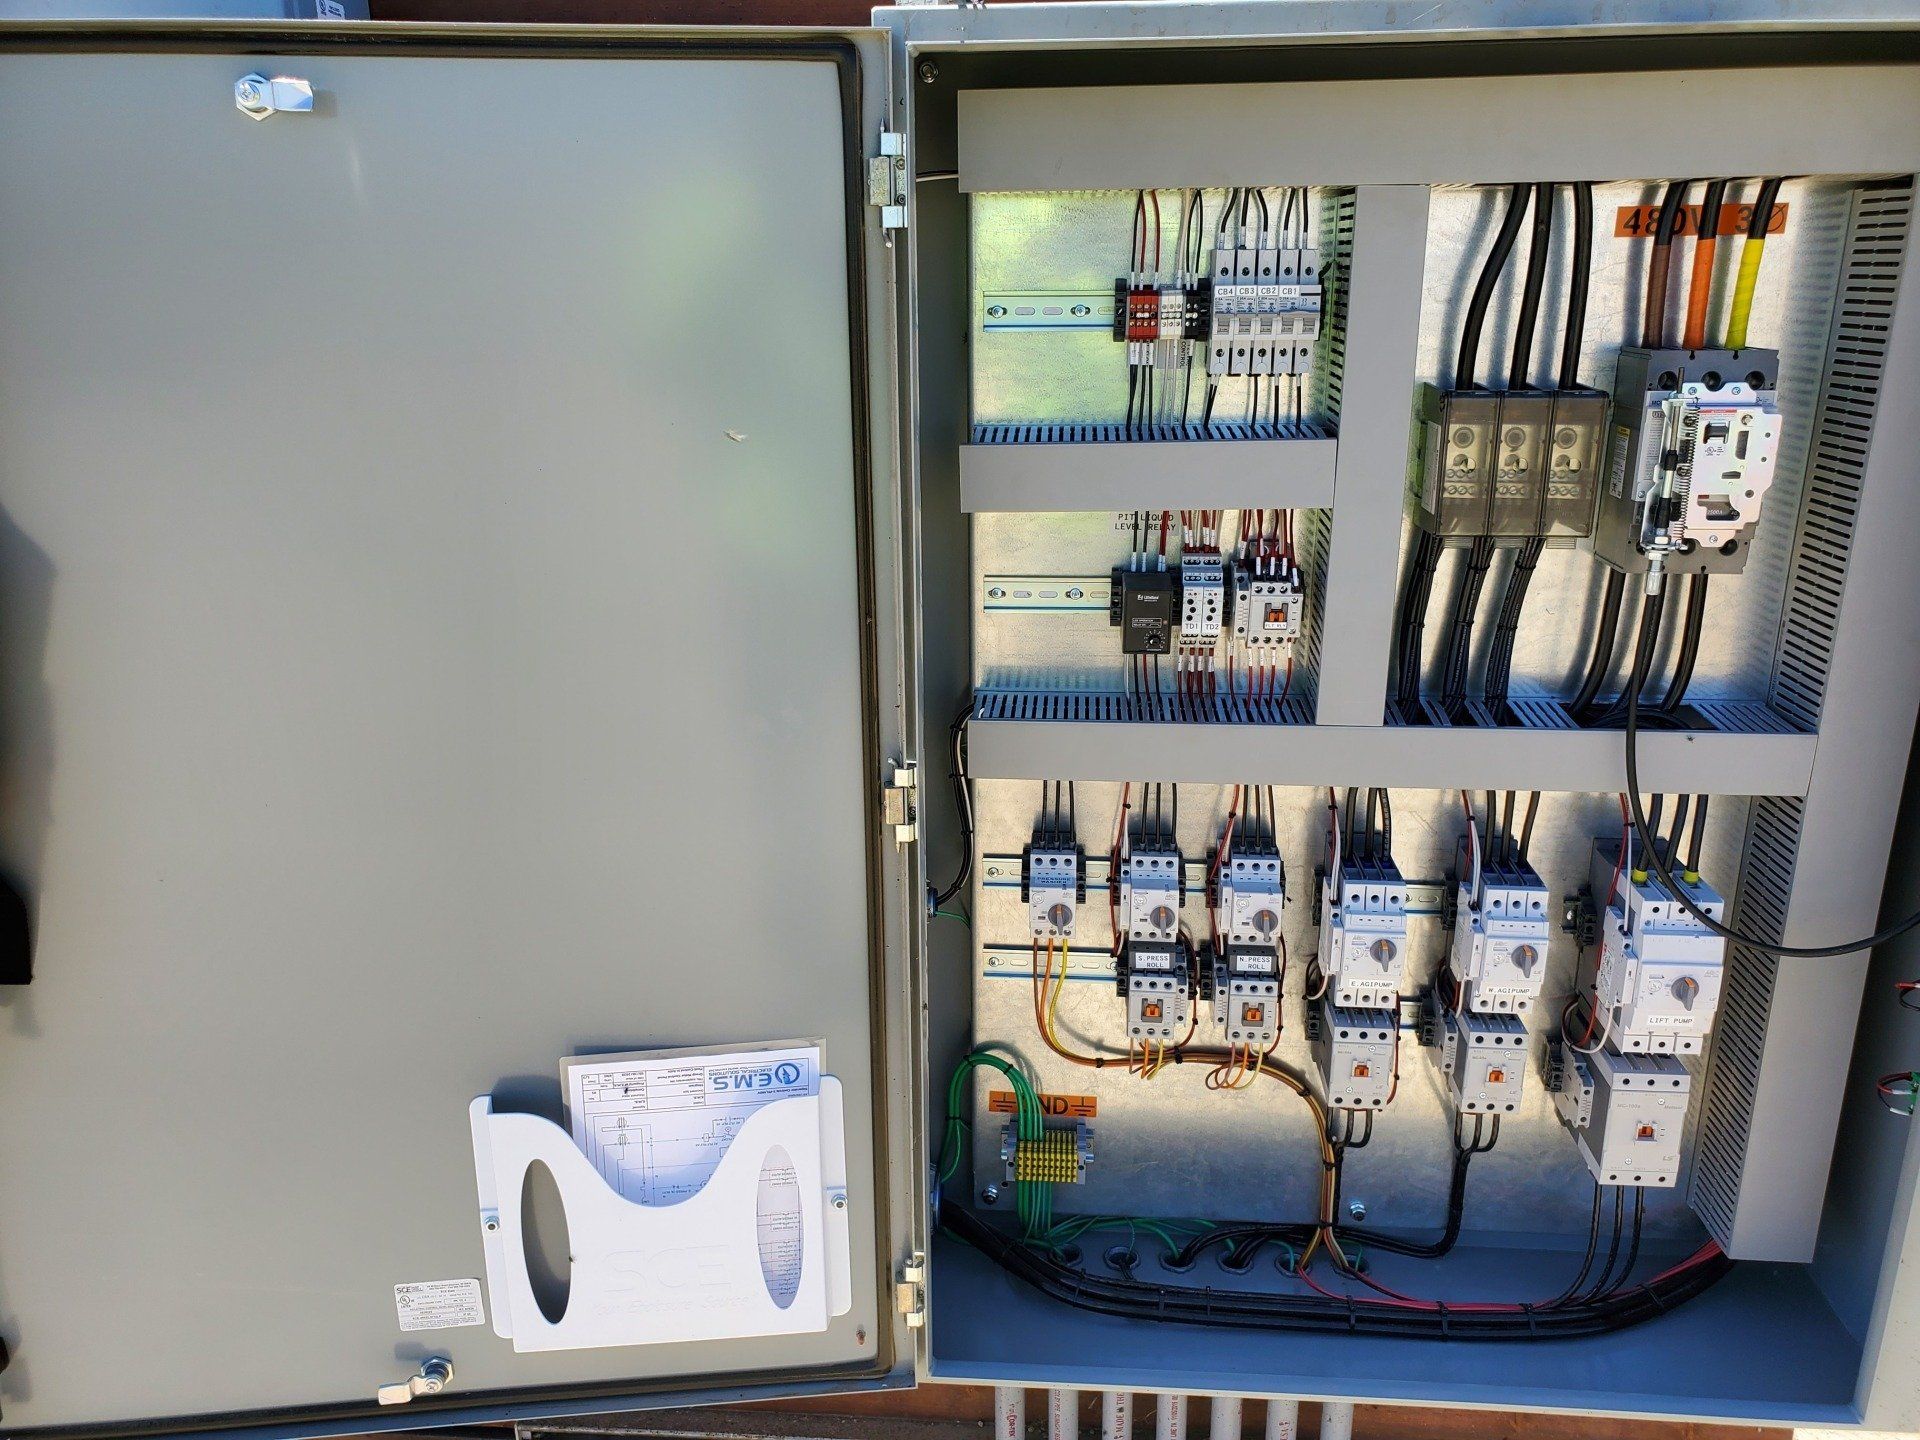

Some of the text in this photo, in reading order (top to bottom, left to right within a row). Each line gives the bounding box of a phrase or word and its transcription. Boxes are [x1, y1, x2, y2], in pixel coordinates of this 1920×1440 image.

[1239, 287, 1255, 295] CB3
[1282, 287, 1297, 295] CB1
[1179, 341, 1187, 369] CONTROL
[1118, 513, 1135, 521] PIT
